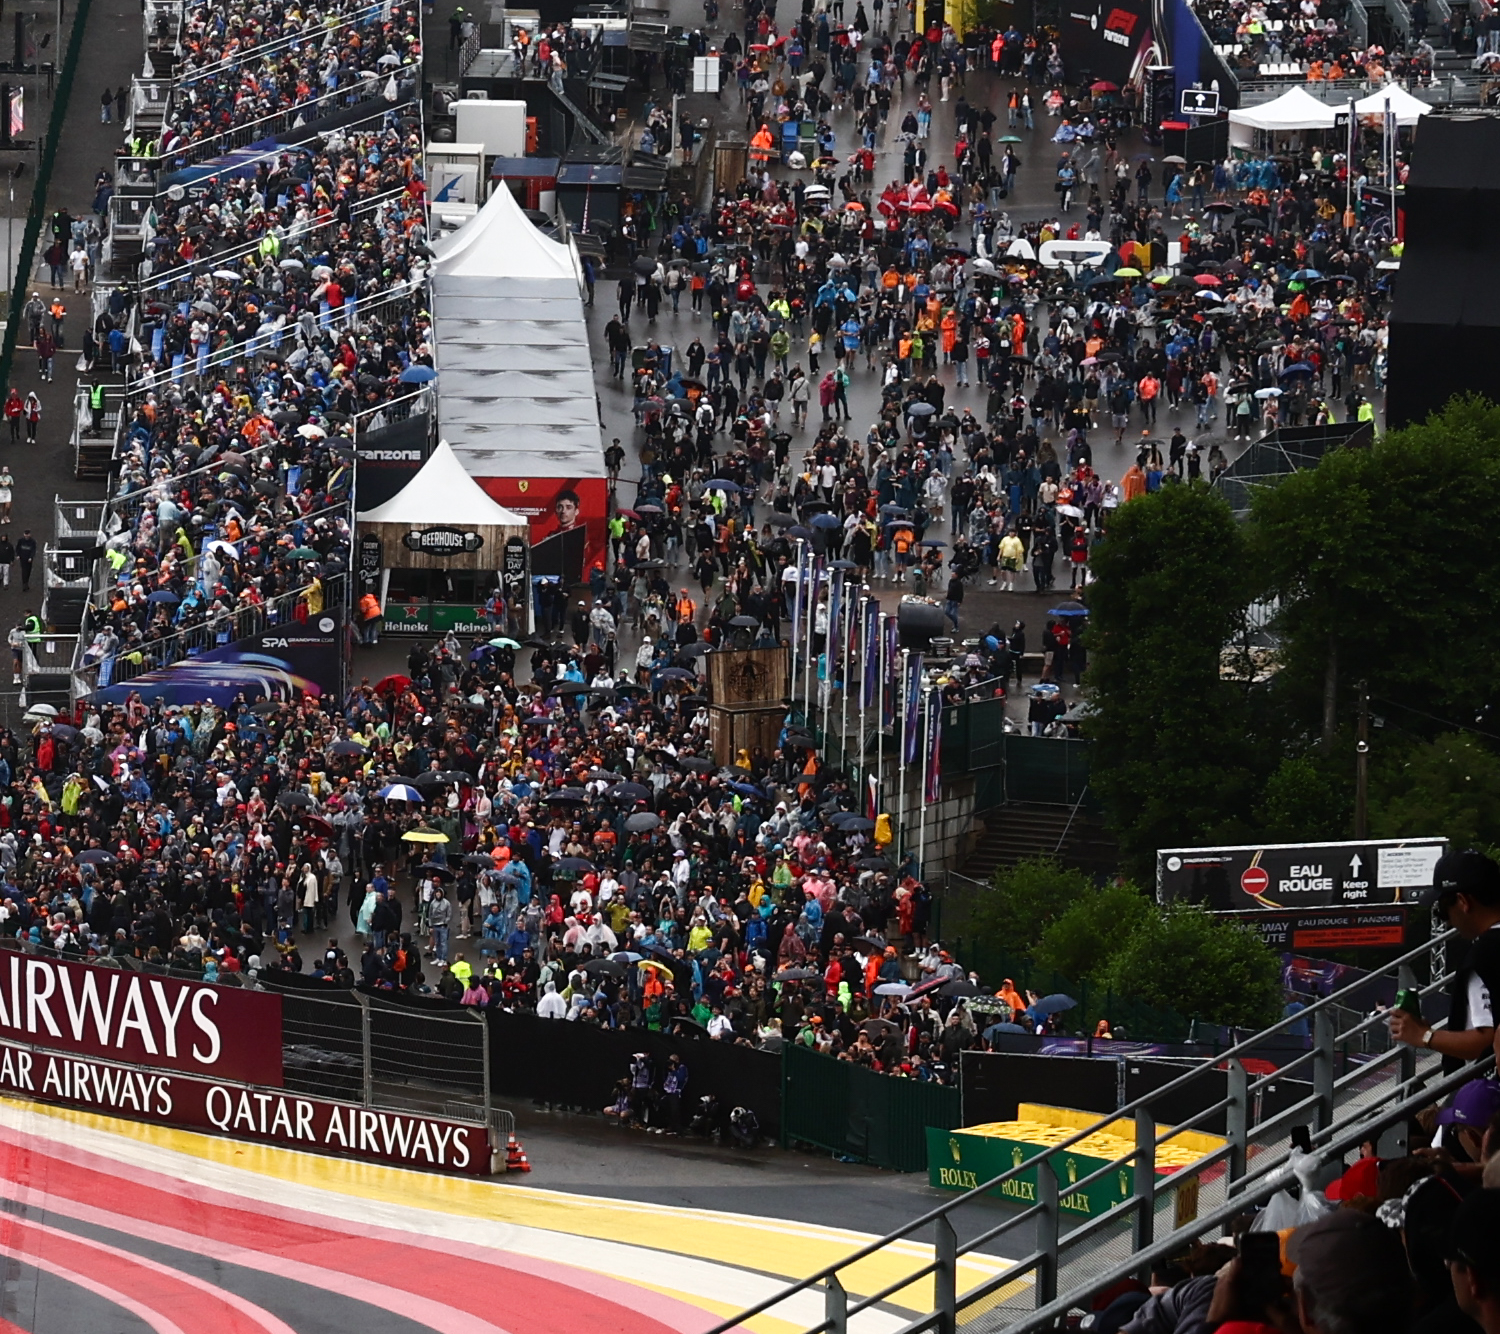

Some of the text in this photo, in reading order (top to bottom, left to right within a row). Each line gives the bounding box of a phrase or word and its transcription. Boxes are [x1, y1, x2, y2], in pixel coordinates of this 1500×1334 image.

[422, 532, 463, 547] BEERHOUSE
[262, 637, 288, 648] SPA
[1290, 864, 1323, 878] EAU
[1279, 878, 1333, 892] ROUGE
[1343, 880, 1368, 890] Keep
[1342, 890, 1368, 899] right
[1298, 915, 1400, 927] EAU ROUGE FANZONE
[43, 1058, 173, 1116] AIRWAYS
[205, 1086, 471, 1168] QATAR AIRWAYS
[939, 1167, 978, 1189] ROLEX
